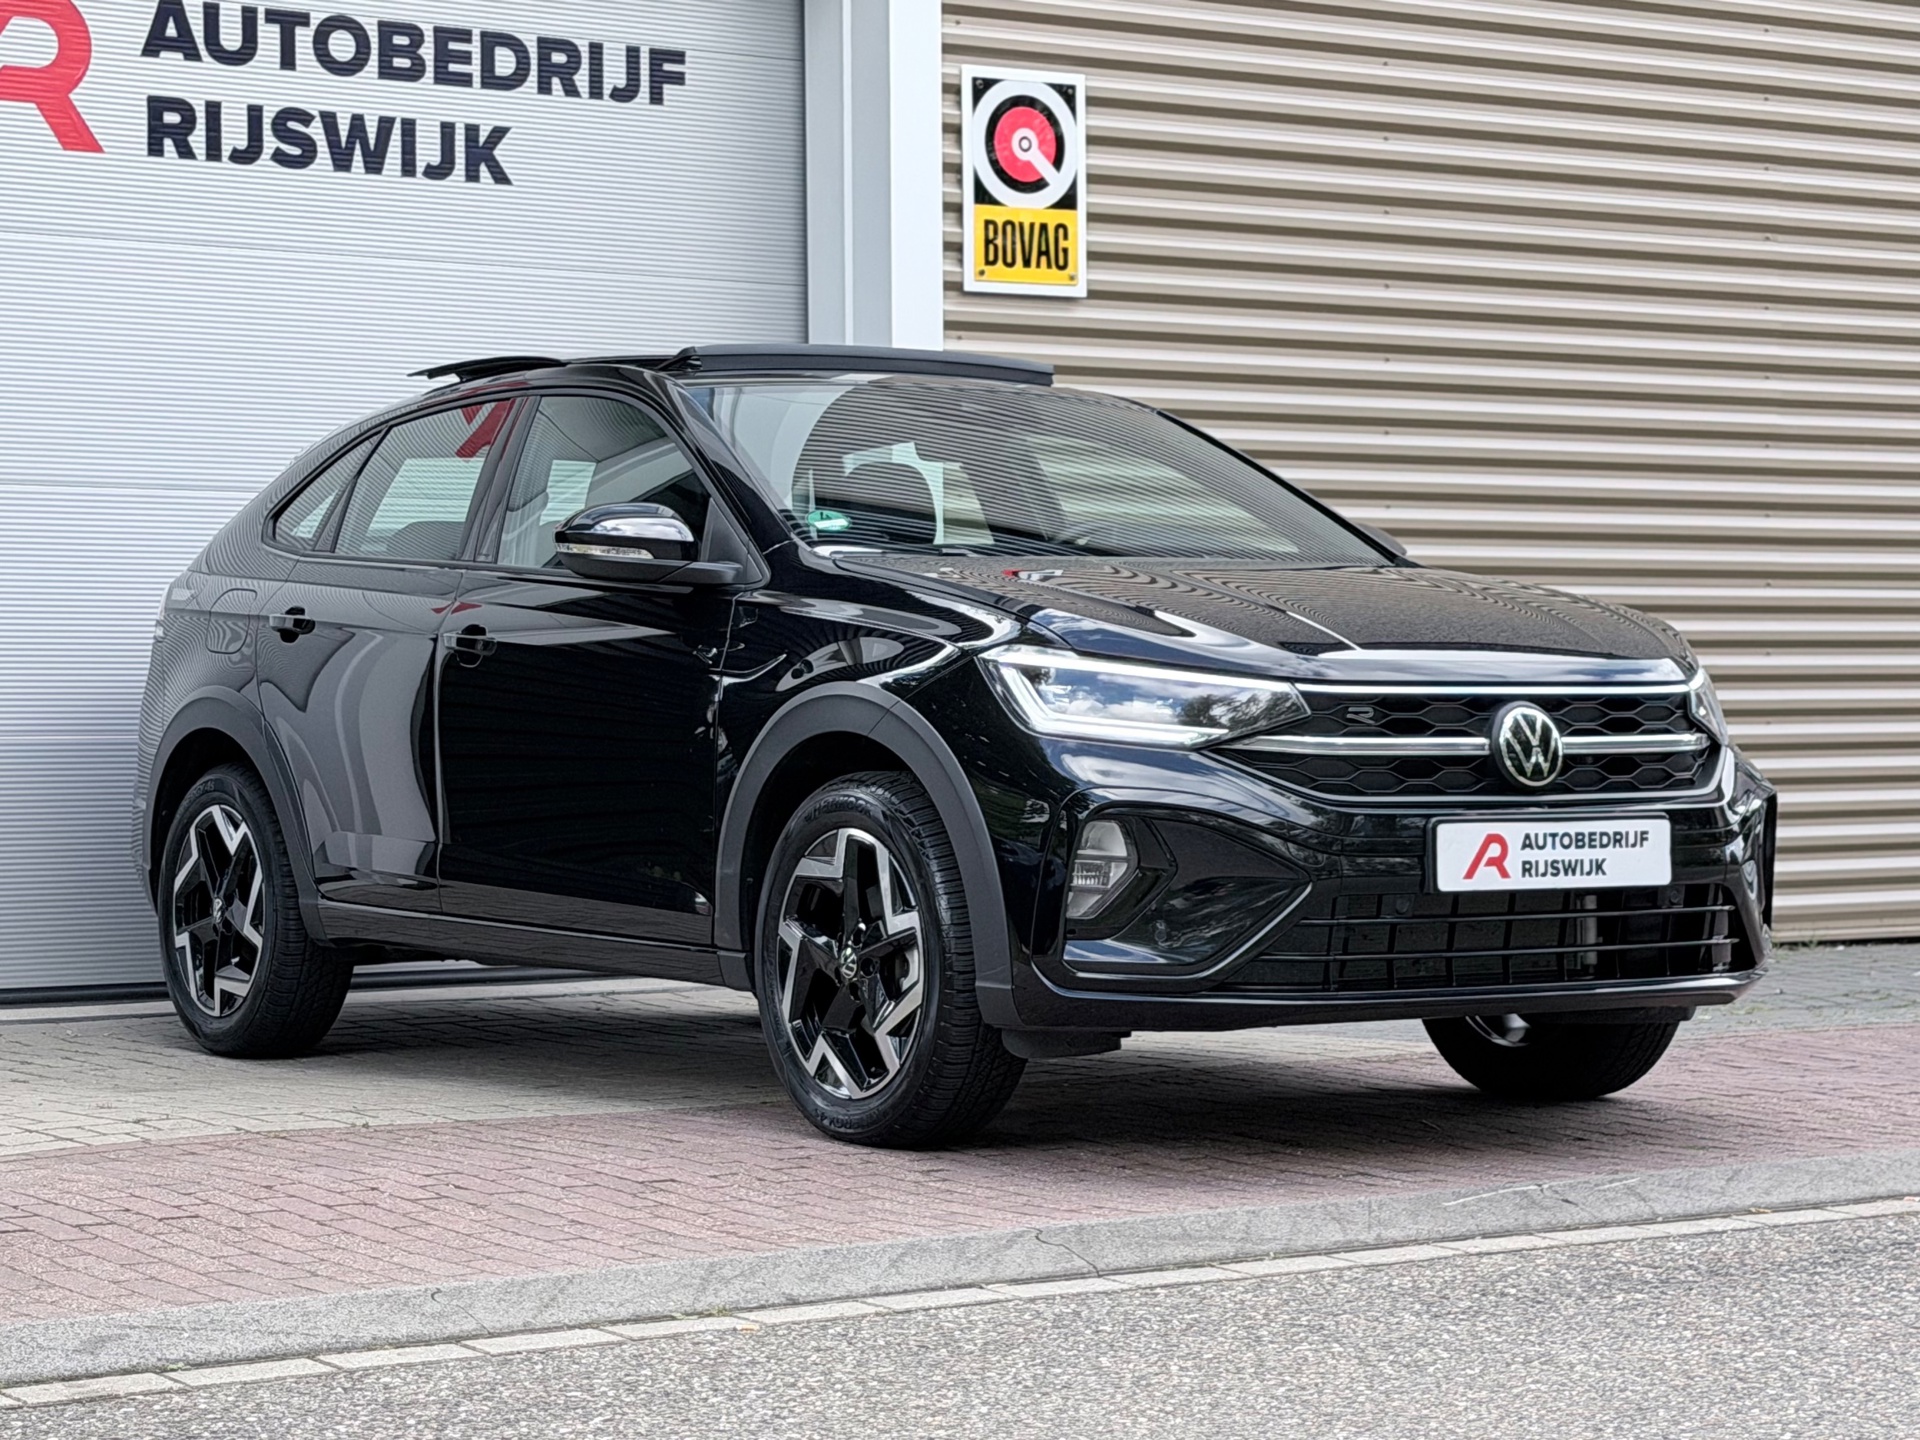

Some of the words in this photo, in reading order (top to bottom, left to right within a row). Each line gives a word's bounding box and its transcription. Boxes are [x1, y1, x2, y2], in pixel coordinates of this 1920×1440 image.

[140, 0, 687, 106] AUTOBEDRIJF
[146, 94, 514, 186] RIJSWIJK
[983, 218, 1070, 271] BOVAG
[1520, 830, 1650, 851] AUTOBEDRIJF
[1521, 858, 1608, 878] RIJSWIJK
